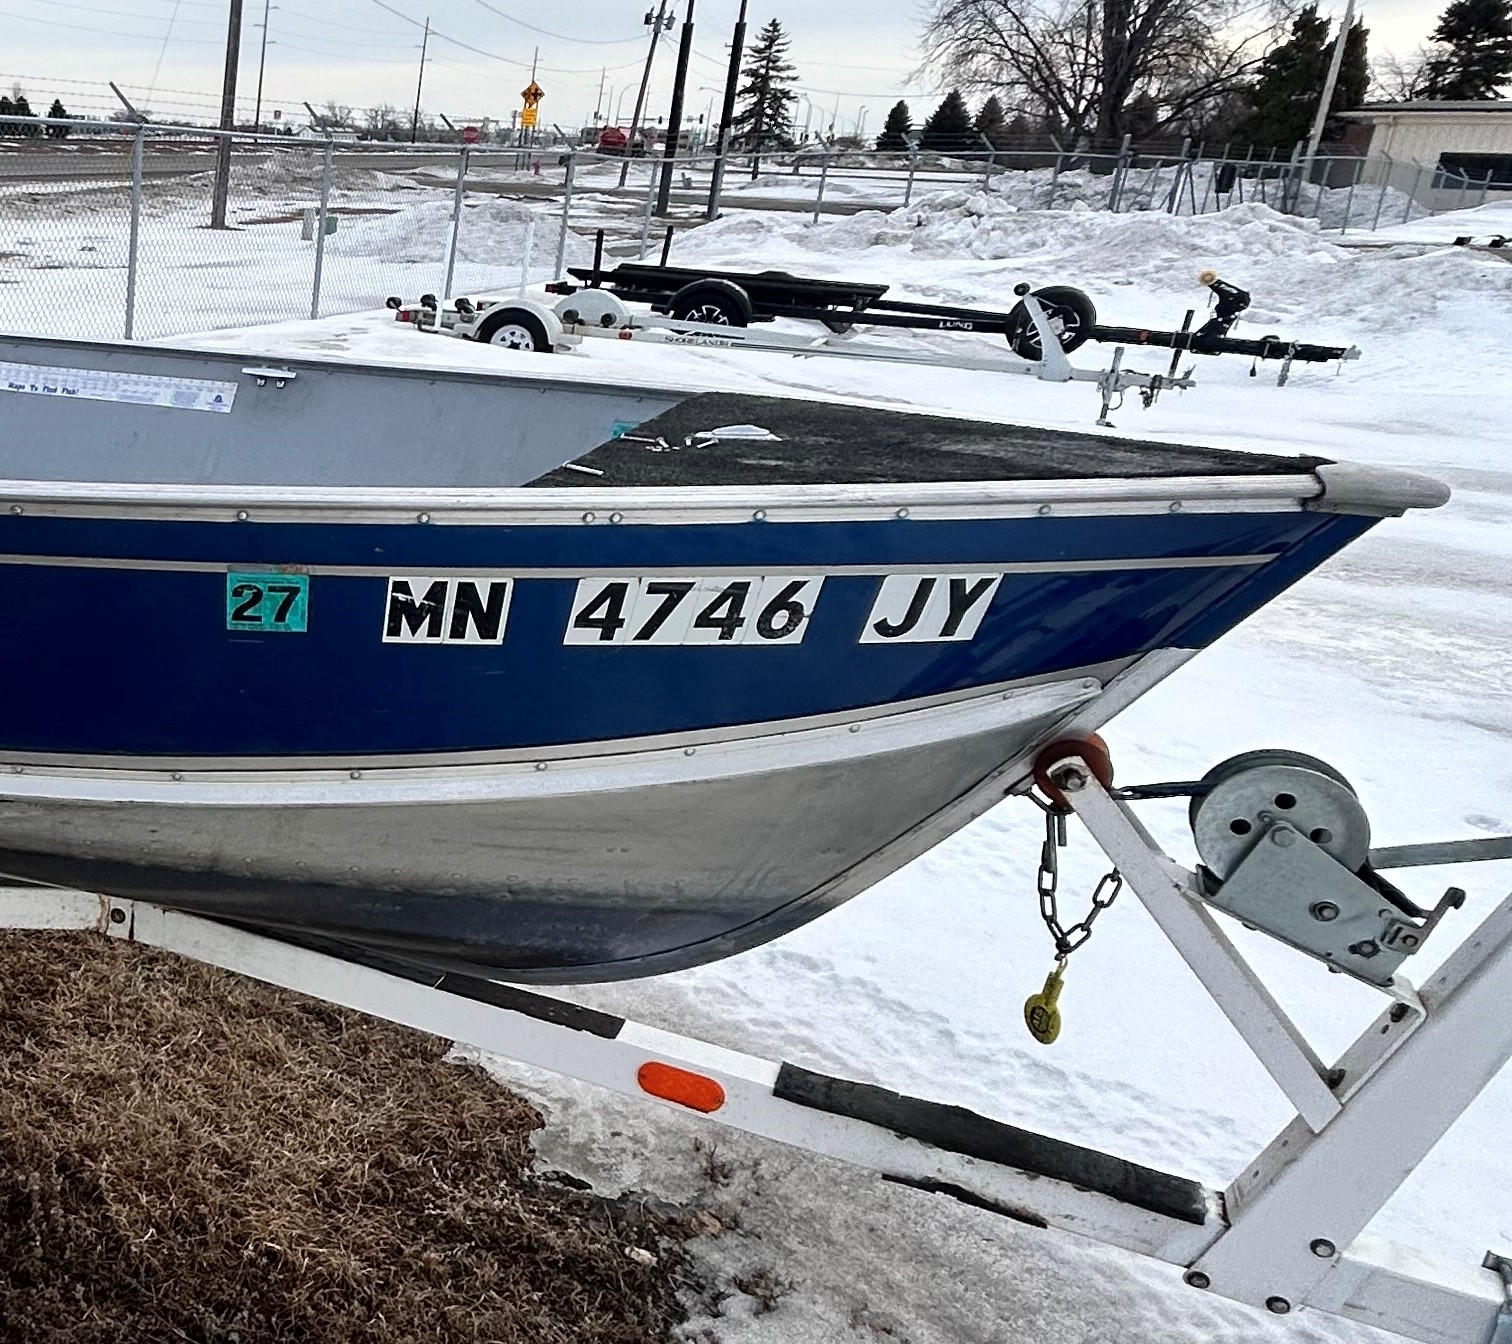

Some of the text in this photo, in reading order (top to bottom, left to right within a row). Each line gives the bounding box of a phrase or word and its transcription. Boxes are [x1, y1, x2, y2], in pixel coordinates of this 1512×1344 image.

[938, 320, 974, 330] LUND
[231, 583, 302, 623] 27
[385, 576, 999, 641] MN 4746 JY
